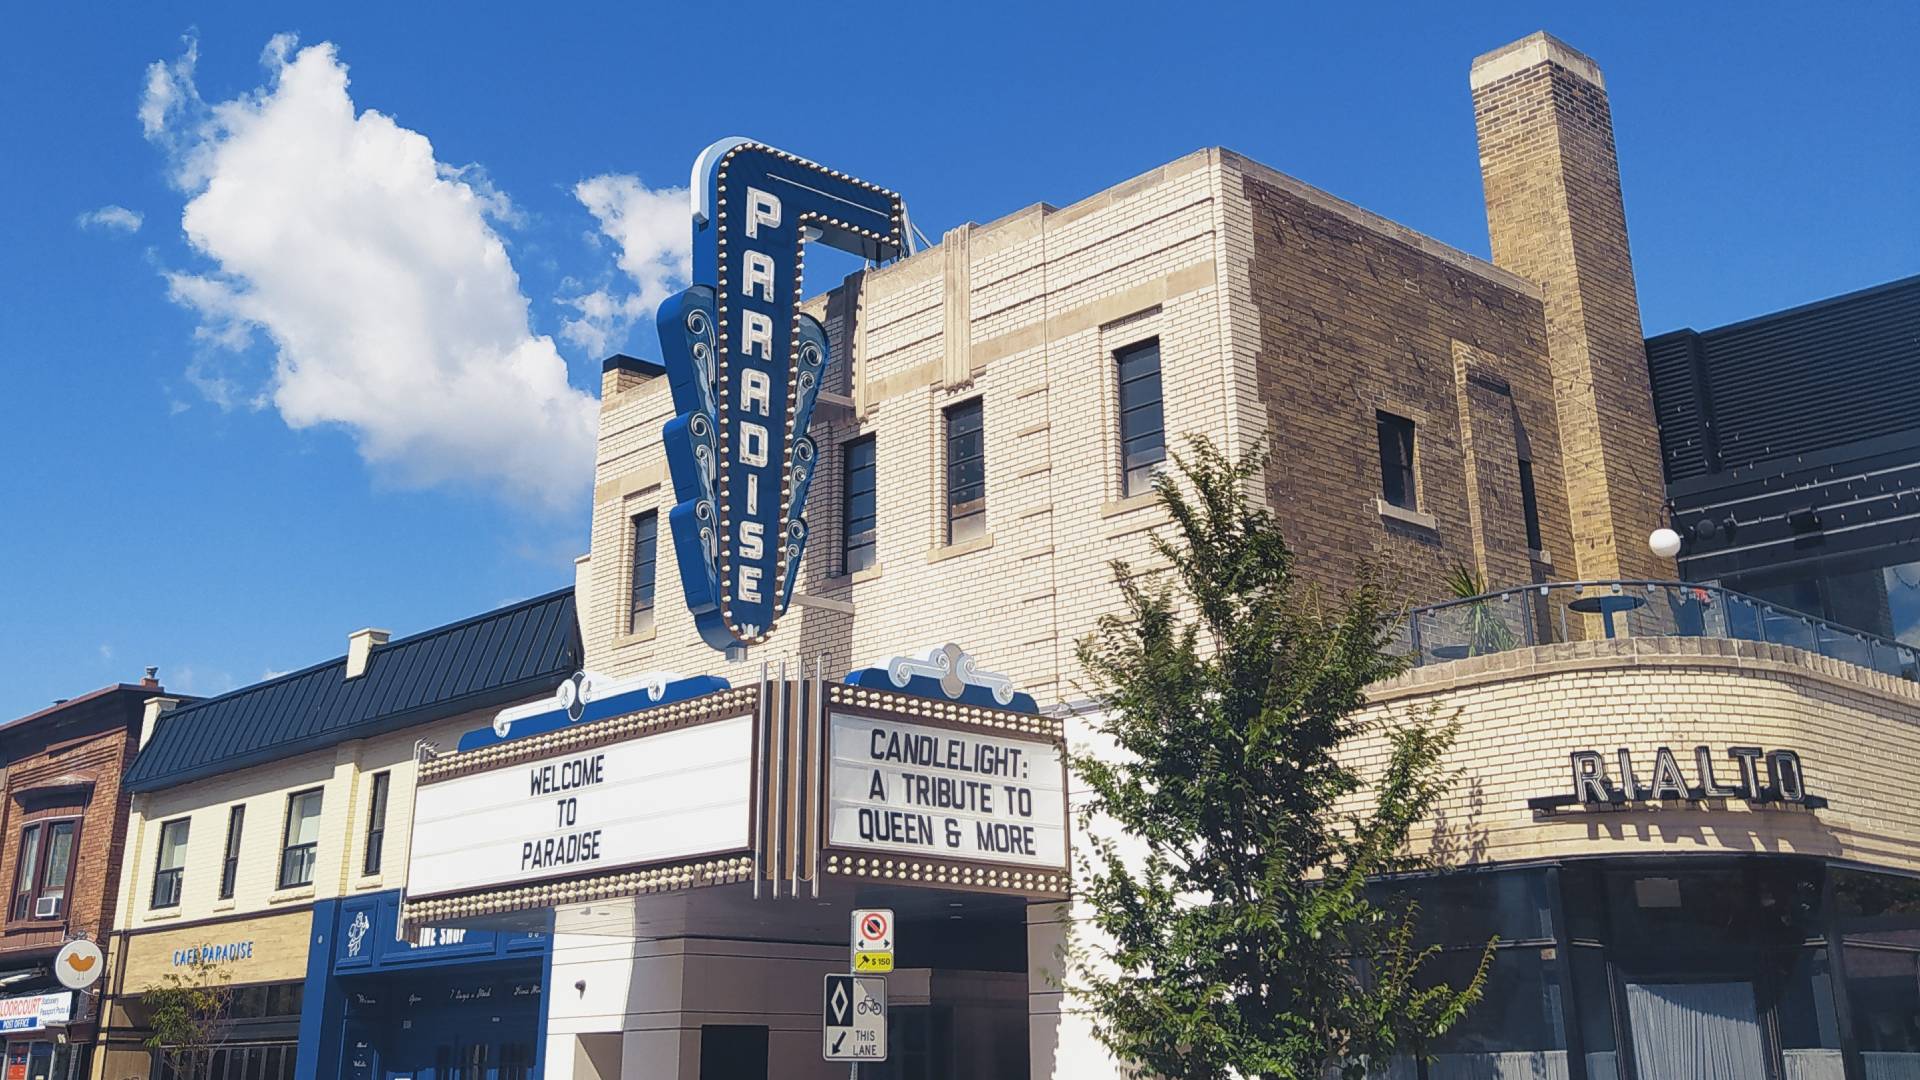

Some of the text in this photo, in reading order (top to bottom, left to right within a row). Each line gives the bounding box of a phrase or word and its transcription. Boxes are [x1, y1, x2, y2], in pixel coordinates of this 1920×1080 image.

[739, 186, 782, 604] PARADISE
[870, 728, 1028, 779] CANDLELIGHT:
[531, 754, 605, 796] WELCOME
[1570, 746, 1806, 803] RIALTO
[868, 769, 1032, 818] A TRIBUTE TO
[557, 797, 577, 828] TO
[858, 808, 1036, 856] QUEEN & MORE
[521, 829, 602, 871] PARADISE
[202, 941, 254, 961] PARADISE
[411, 927, 437, 948] INE
[878, 957, 891, 966] 150
[0, 998, 41, 1017] LOORCOURT
[3, 1019, 13, 1029] POST
[14, 1018, 29, 1028] OFFICE
[855, 1030, 875, 1041] THIS
[853, 1044, 877, 1056] LANE
